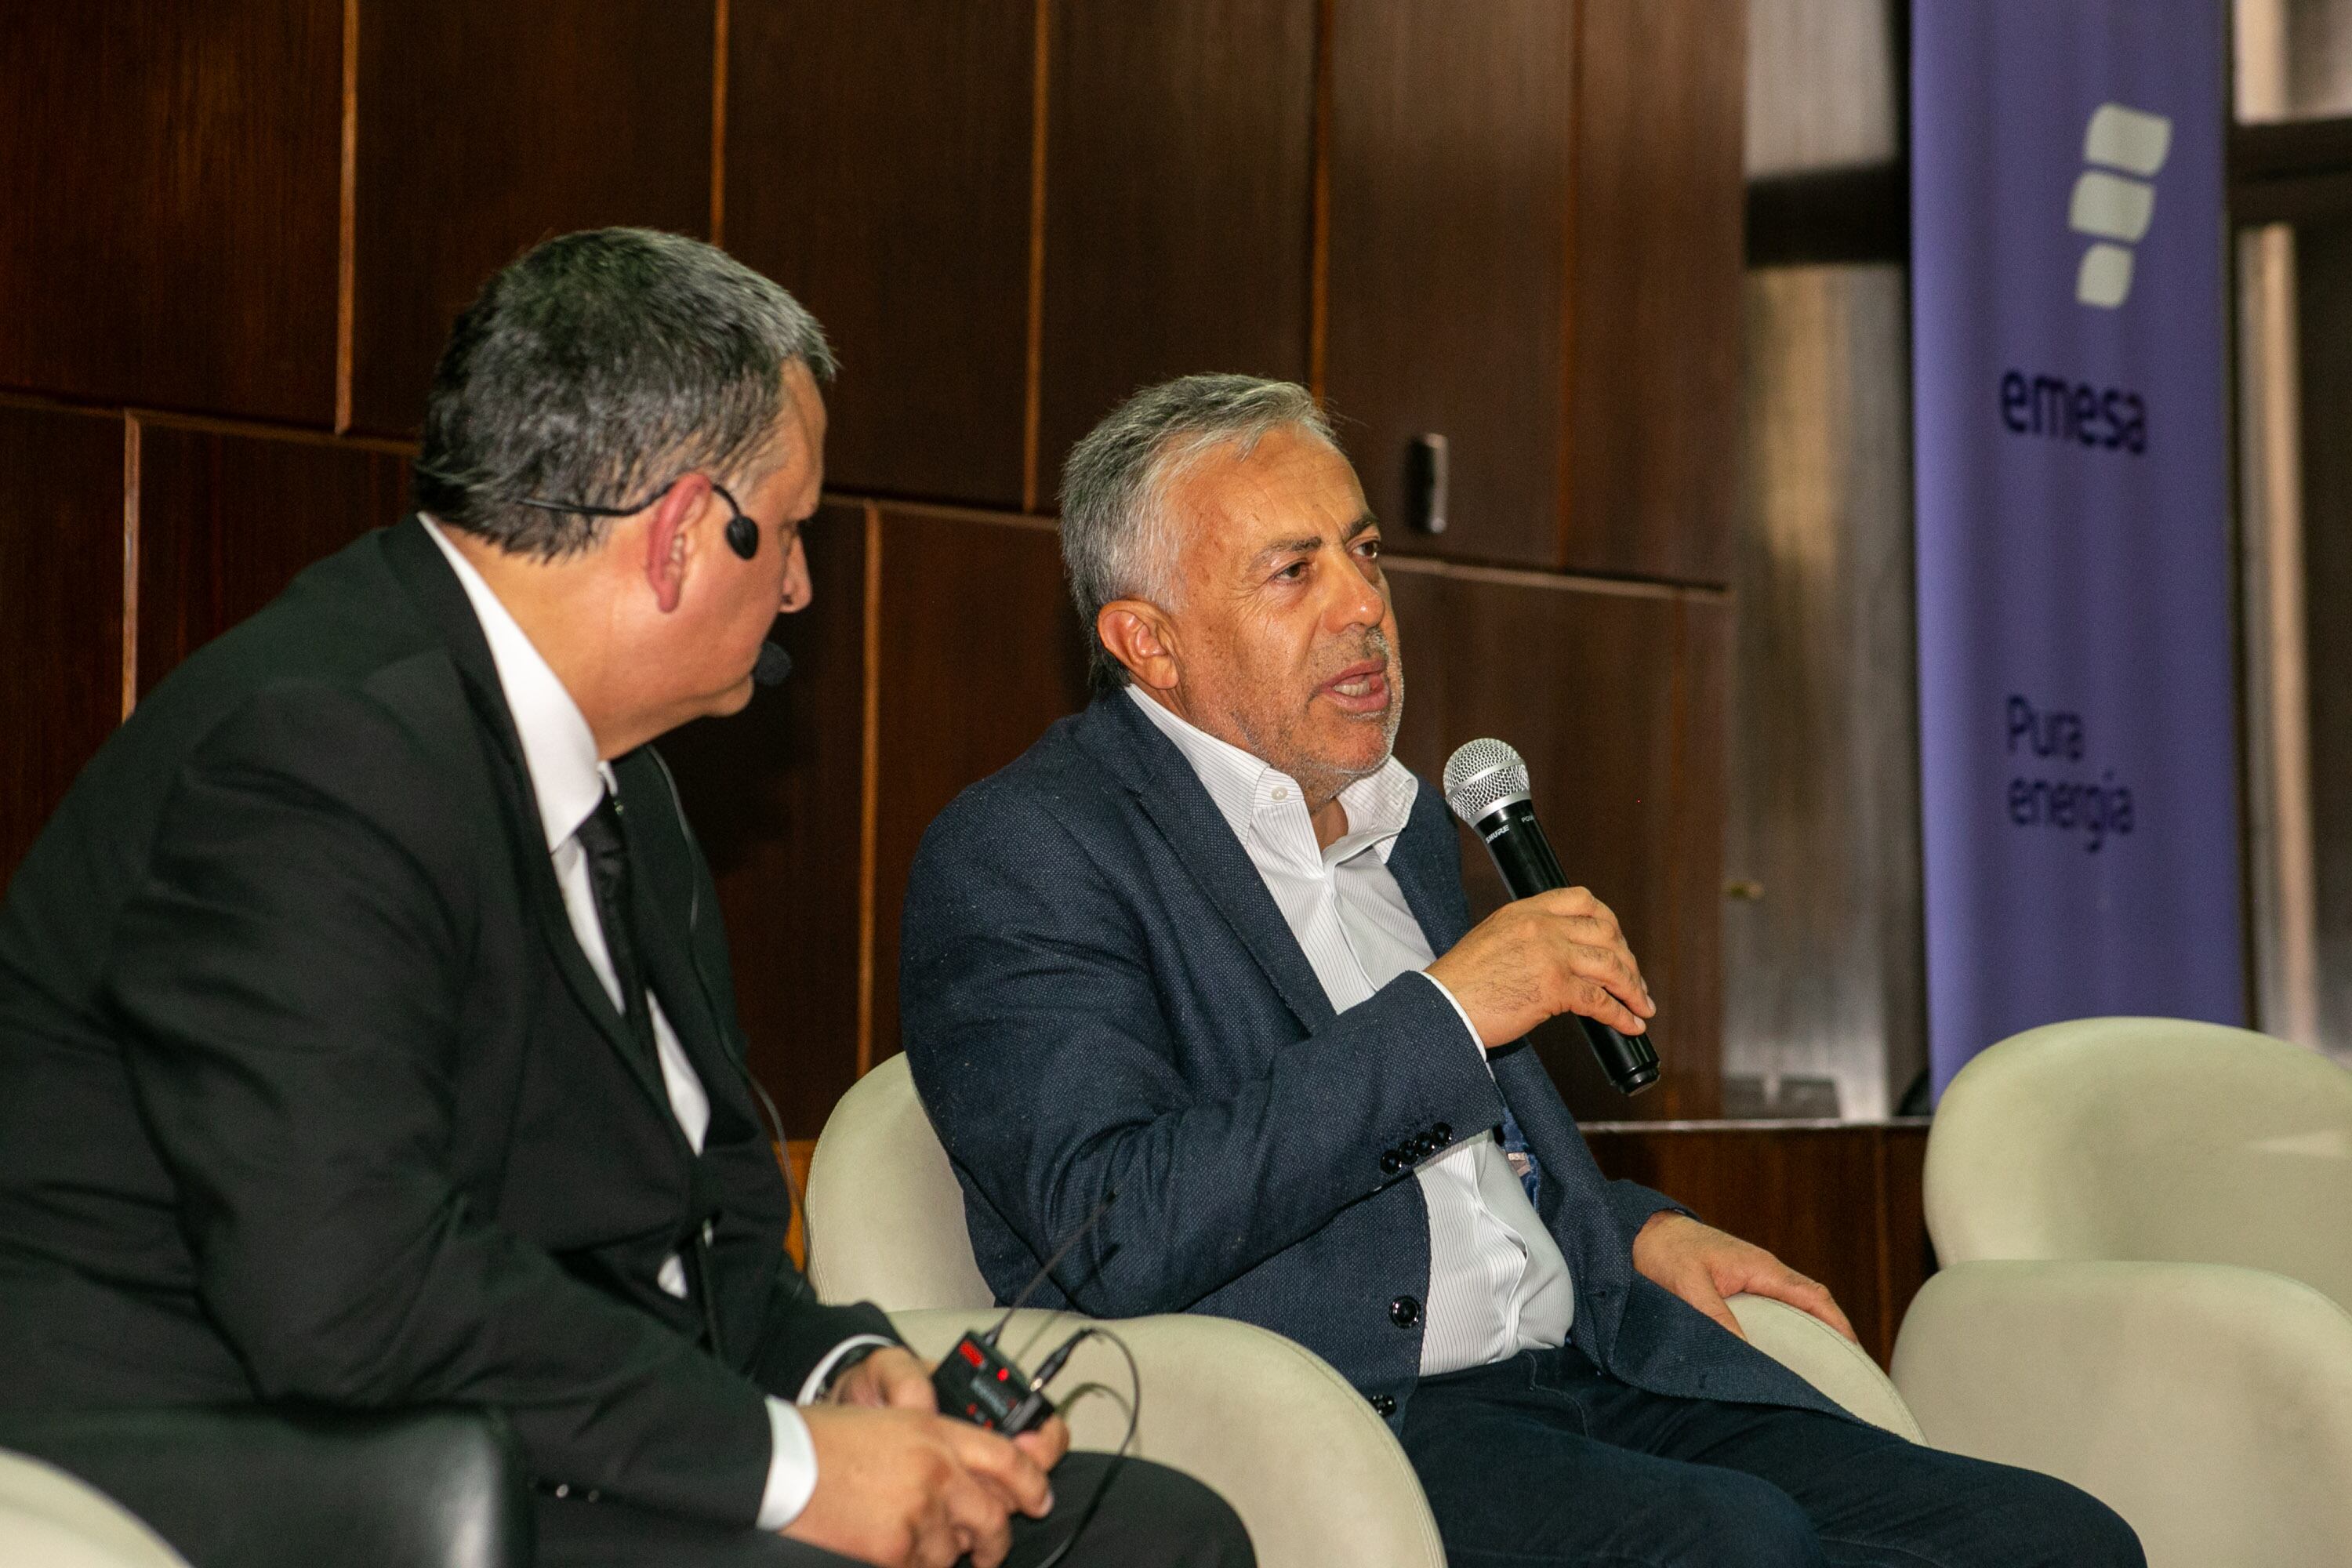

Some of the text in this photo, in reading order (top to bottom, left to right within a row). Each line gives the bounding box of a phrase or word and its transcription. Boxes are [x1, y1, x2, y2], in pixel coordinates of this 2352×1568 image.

[2002, 370, 2146, 454] emesa
[2008, 694, 2082, 760] Pura
[1486, 824, 1510, 844] SHURE
[2009, 768, 2132, 854] energía
